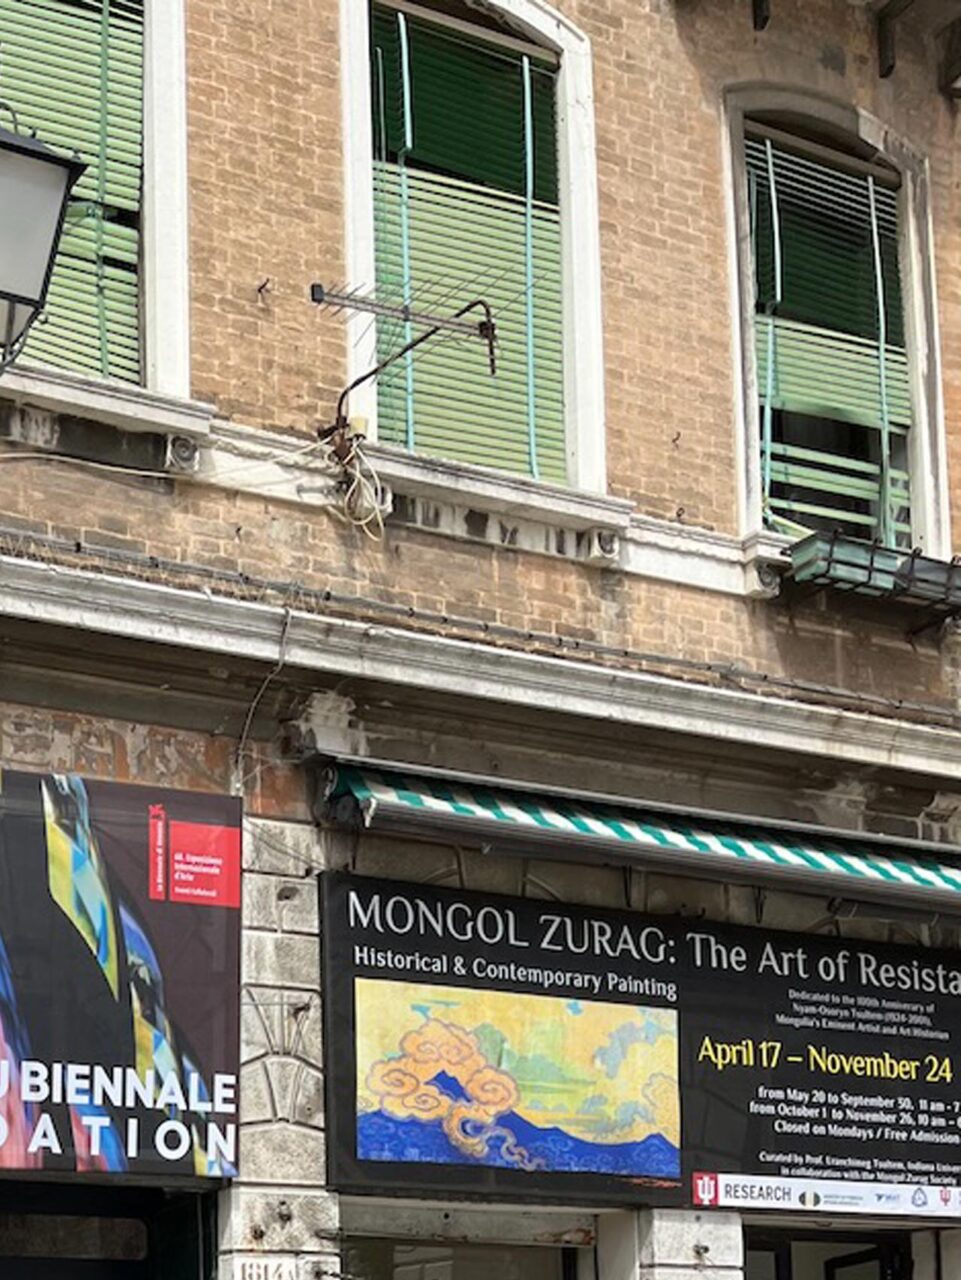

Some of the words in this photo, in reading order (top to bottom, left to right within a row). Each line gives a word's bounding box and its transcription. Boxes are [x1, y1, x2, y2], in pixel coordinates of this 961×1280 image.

[348, 890, 530, 948] MONGOL
[539, 914, 676, 965] ZURAG:
[686, 932, 747, 972] The
[758, 941, 809, 979] Art
[818, 950, 851, 983] of
[355, 945, 448, 973] Historical
[453, 957, 468, 975] &
[473, 958, 602, 993] Contemporary
[608, 973, 677, 1001] Painting
[698, 1036, 754, 1070] April
[759, 1041, 782, 1069] 17
[808, 1045, 920, 1080] November
[924, 1055, 954, 1083] 24
[20, 1060, 237, 1113] BIENNALE
[758, 1085, 785, 1099] from
[787, 1088, 809, 1104] May
[811, 1090, 827, 1104] 20
[828, 1093, 839, 1105] to
[841, 1093, 895, 1110] September
[929, 1101, 945, 1113] am
[750, 1101, 775, 1115] from
[777, 1103, 820, 1119] October
[831, 1108, 843, 1121] to
[845, 1109, 898, 1124] November
[930, 1117, 946, 1127] am
[774, 1120, 810, 1135] Closed
[812, 1124, 826, 1135] on
[828, 1123, 874, 1142] Mondays
[875, 1127, 883, 1140] /
[884, 1128, 908, 1141] Free
[909, 1130, 960, 1144] Admission
[724, 1183, 792, 1202] RESEARCH
